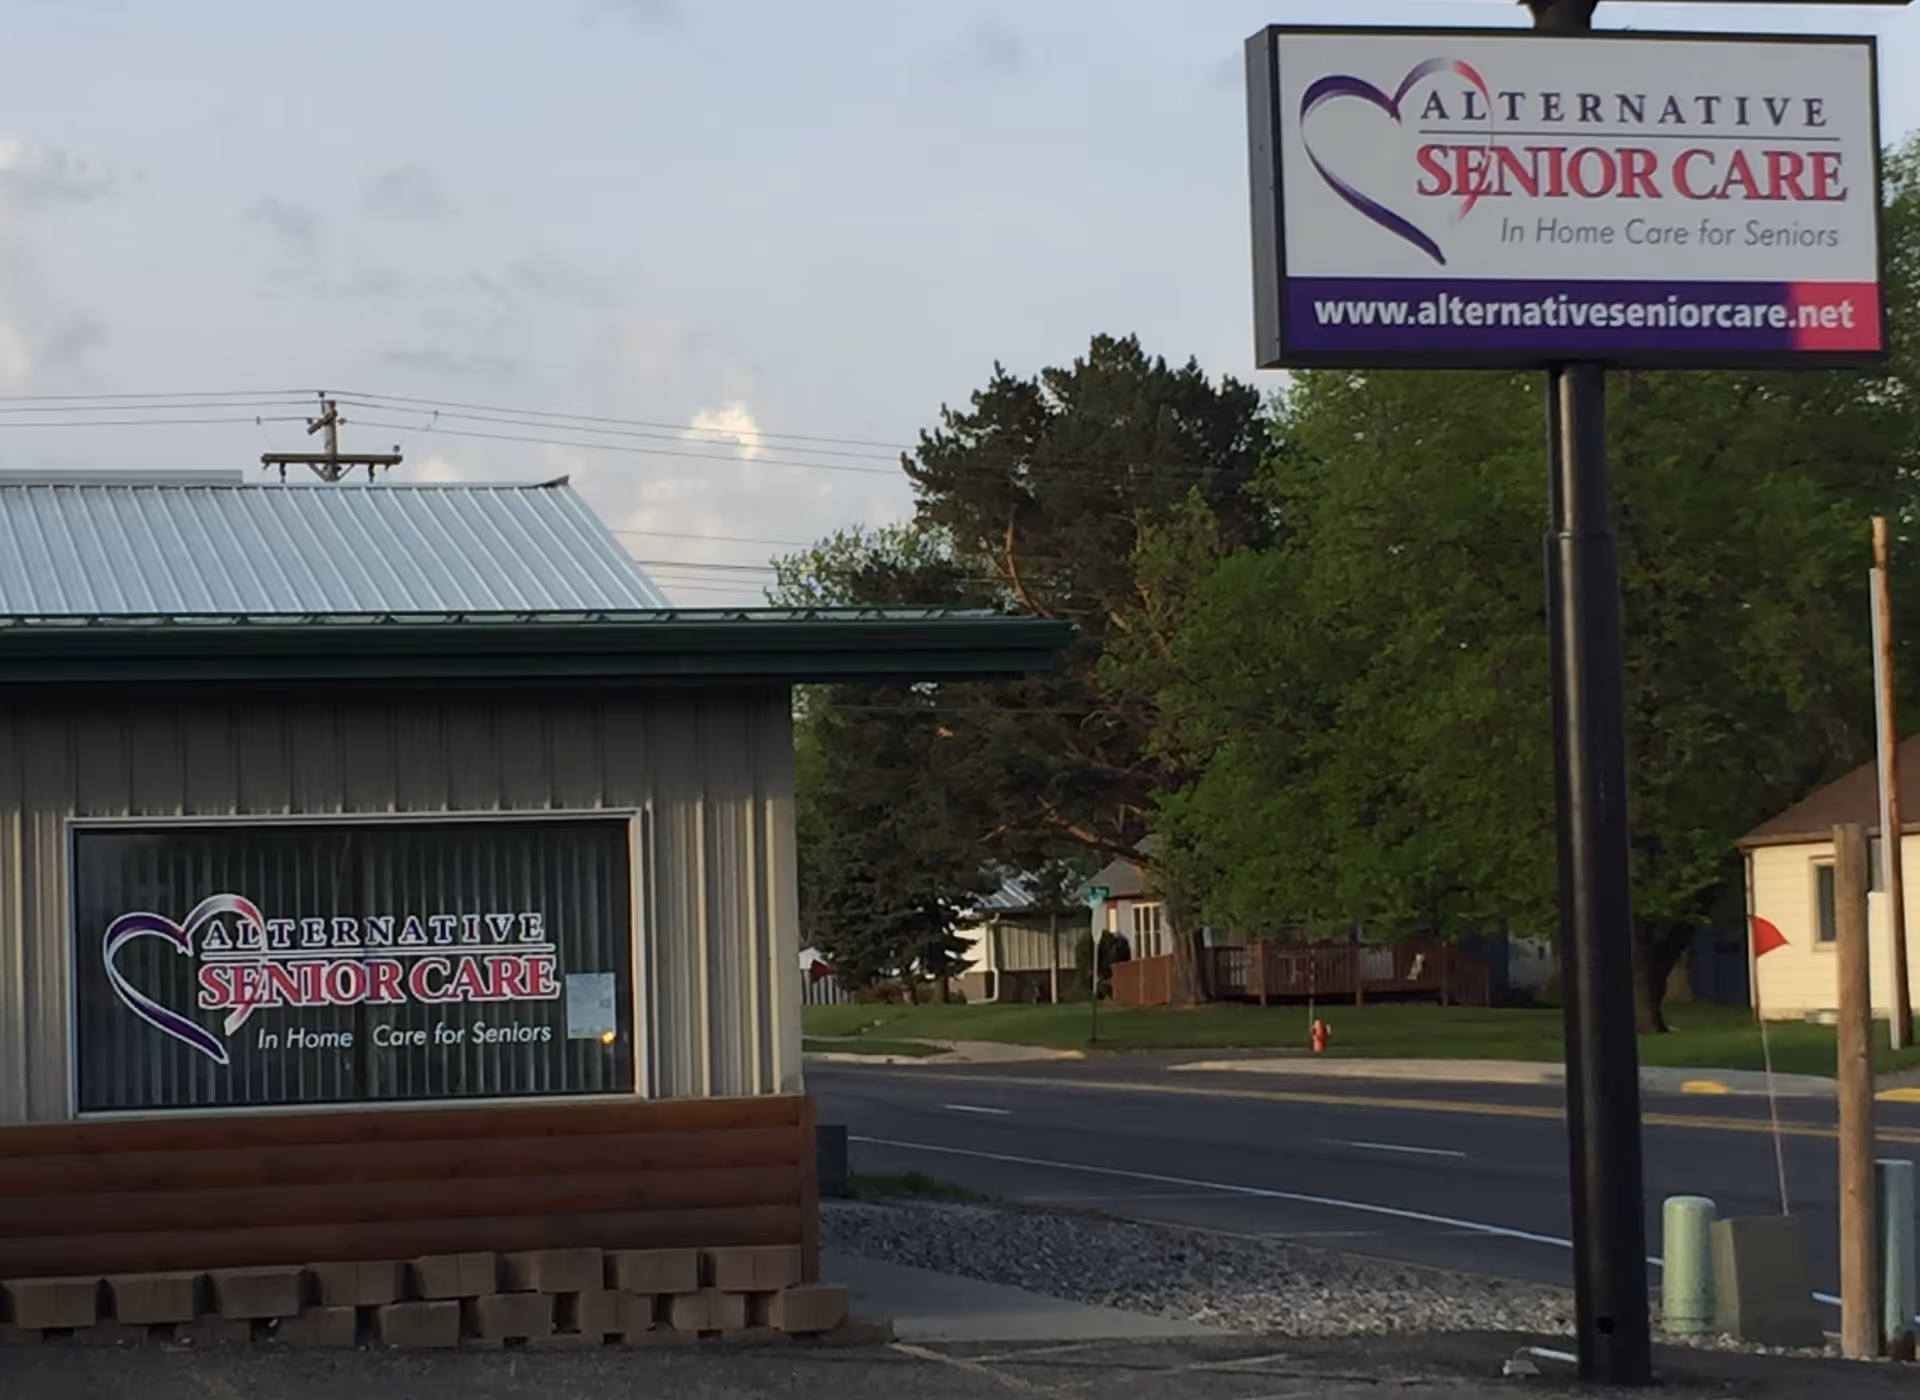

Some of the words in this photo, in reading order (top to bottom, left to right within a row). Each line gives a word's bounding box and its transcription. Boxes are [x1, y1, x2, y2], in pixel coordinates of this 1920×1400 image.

[1420, 90, 1828, 127] ALTERNATIVE
[1417, 144, 1662, 199] SENIOR
[1672, 148, 1848, 201] CARE
[1501, 219, 1524, 243] In
[1536, 219, 1615, 244] Home
[1626, 220, 1689, 245] Care
[1698, 219, 1735, 246] for
[1744, 220, 1838, 248] Seniors
[1315, 293, 1854, 330] www.alternativeseniorcare.net
[204, 913, 545, 947] ALTERNATIVE
[200, 957, 407, 1008] SENIOR
[409, 955, 560, 1002] CARE
[258, 1028, 278, 1049] In
[287, 1027, 353, 1049] Home
[373, 1024, 426, 1047] Care
[434, 1022, 465, 1046] for
[471, 1020, 552, 1044] Seniors
